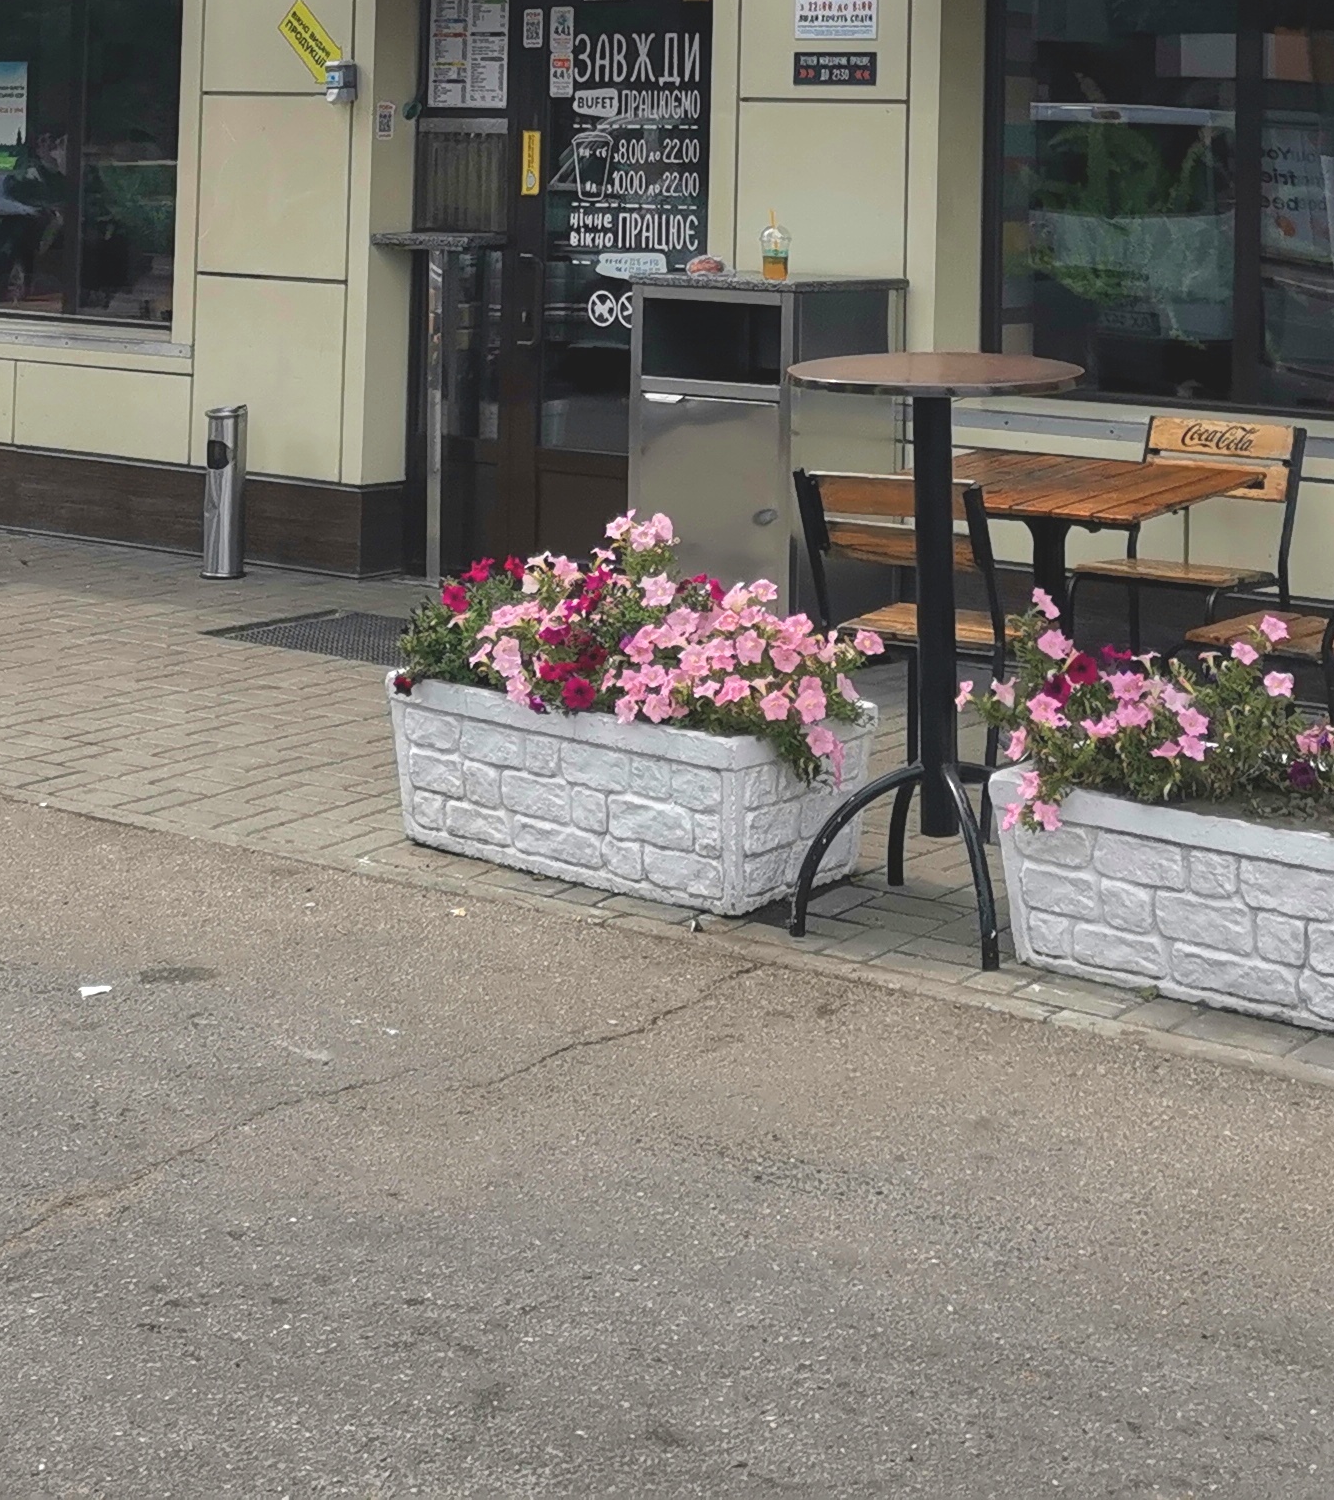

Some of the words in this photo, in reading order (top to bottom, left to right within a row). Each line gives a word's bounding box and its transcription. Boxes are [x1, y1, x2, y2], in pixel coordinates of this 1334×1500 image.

[574, 32, 700, 87] ЗАВЖДИ
[577, 96, 615, 110] BUFET
[619, 138, 647, 164] 8.00
[663, 138, 700, 164] 22.00
[612, 170, 645, 195] 10.00
[662, 172, 699, 196] 22.00
[569, 208, 613, 229] нічне
[618, 213, 699, 252] ПРАЦЮЄ
[569, 228, 613, 249] вікно
